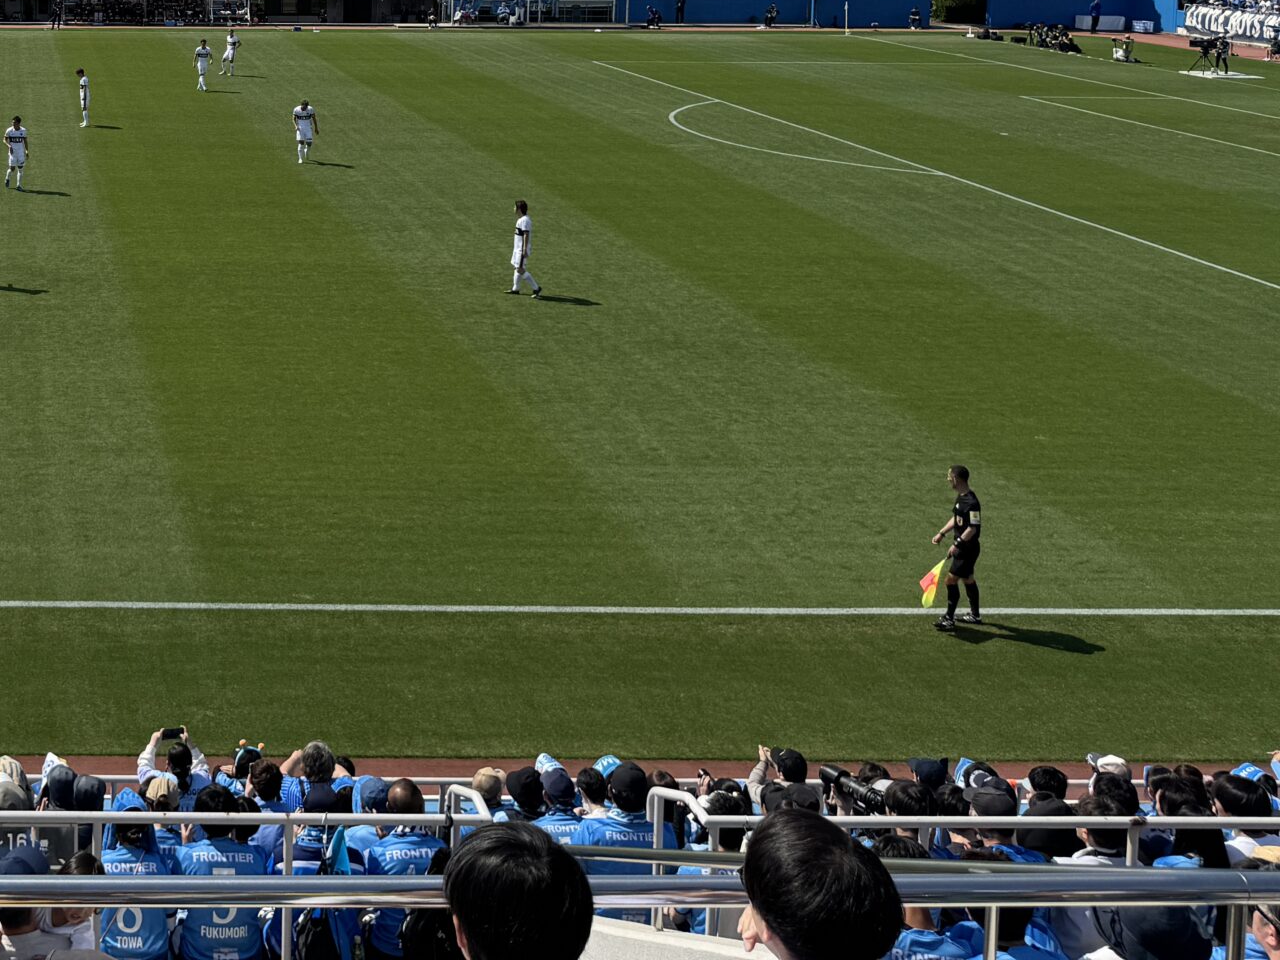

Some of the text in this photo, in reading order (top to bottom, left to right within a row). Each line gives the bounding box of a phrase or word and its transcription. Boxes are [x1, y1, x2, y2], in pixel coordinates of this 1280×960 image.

[1226, 10, 1265, 38] BOYS
[605, 831, 654, 841] FRONTIE
[192, 851, 254, 864] FRONTIER
[201, 925, 248, 939] FUKUMORI
[116, 936, 143, 948] TOWA
